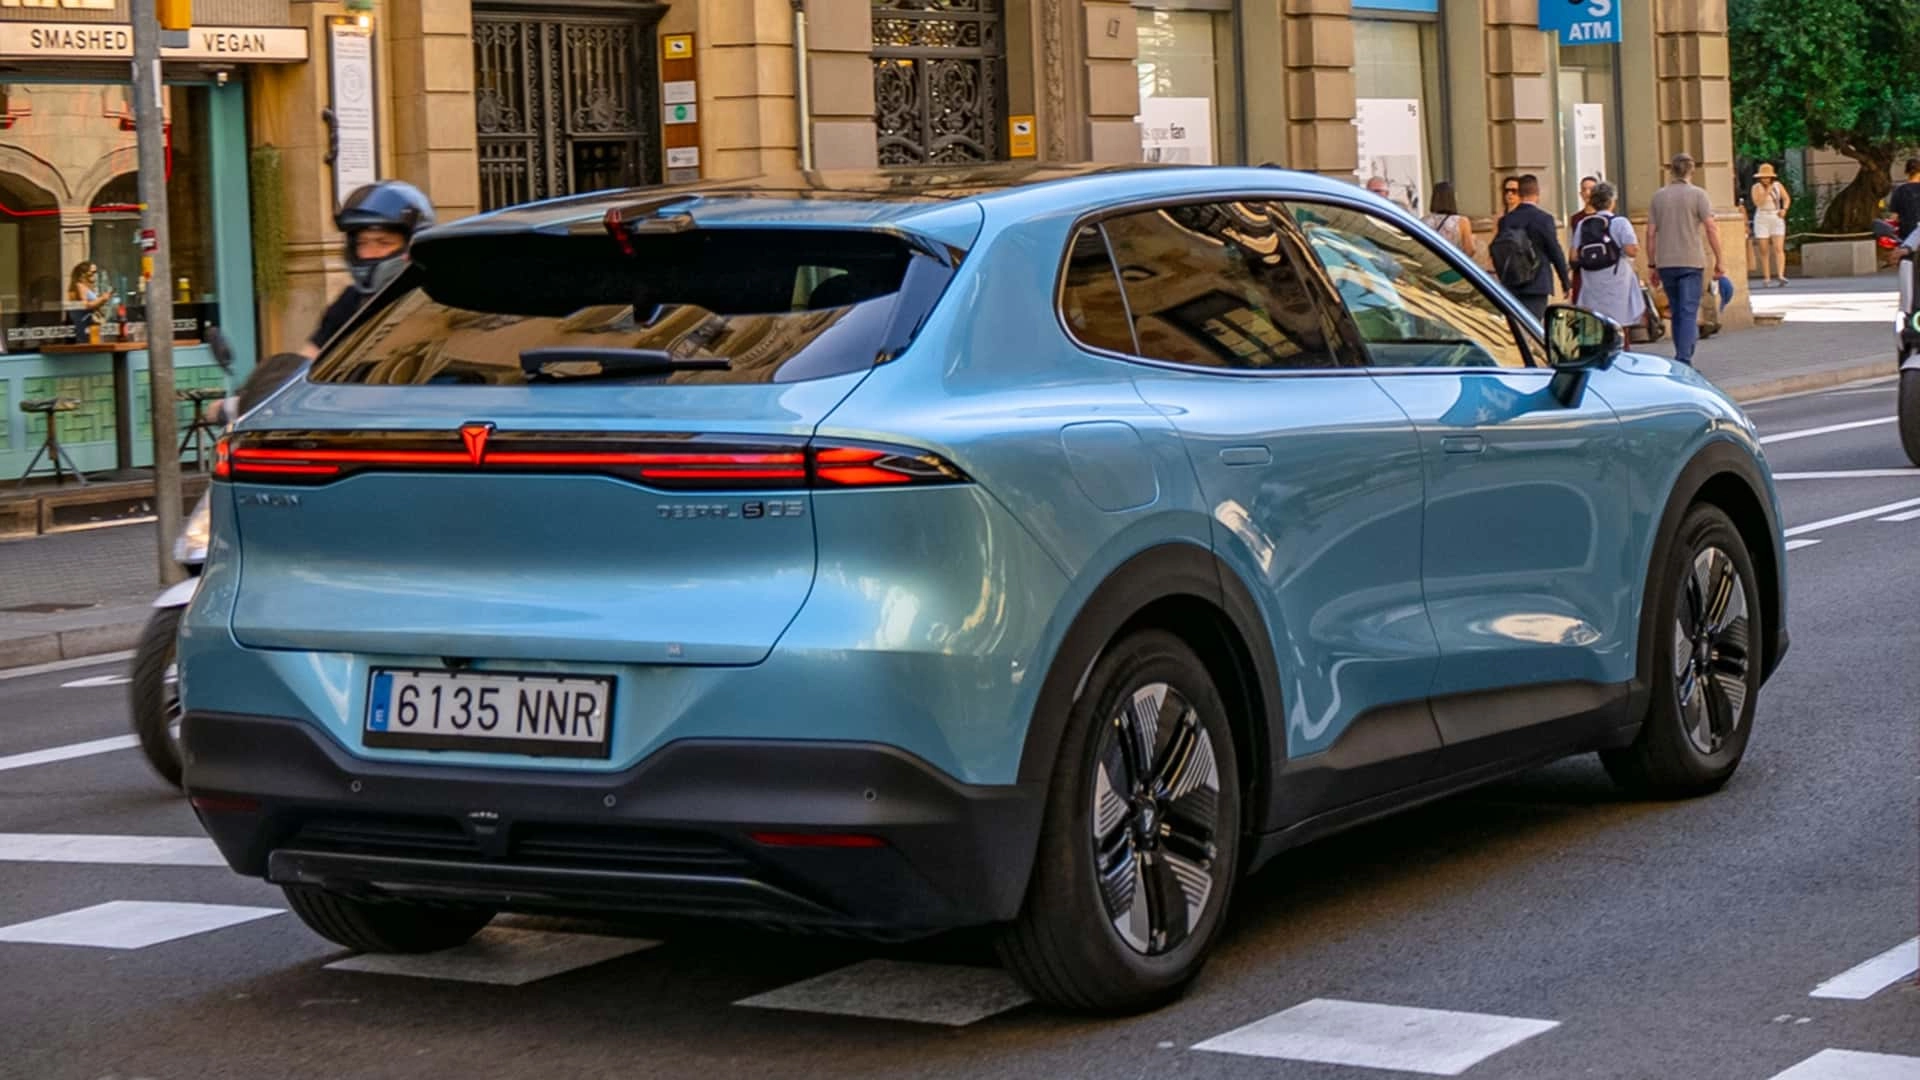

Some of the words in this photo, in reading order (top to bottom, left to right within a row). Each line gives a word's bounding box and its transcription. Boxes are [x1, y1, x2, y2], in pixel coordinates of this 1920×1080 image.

[30, 28, 129, 50] SMASHED
[1568, 21, 1612, 41] ATM
[203, 33, 266, 52] VEGAN
[397, 684, 500, 731] 6135
[515, 688, 598, 737] NNR
